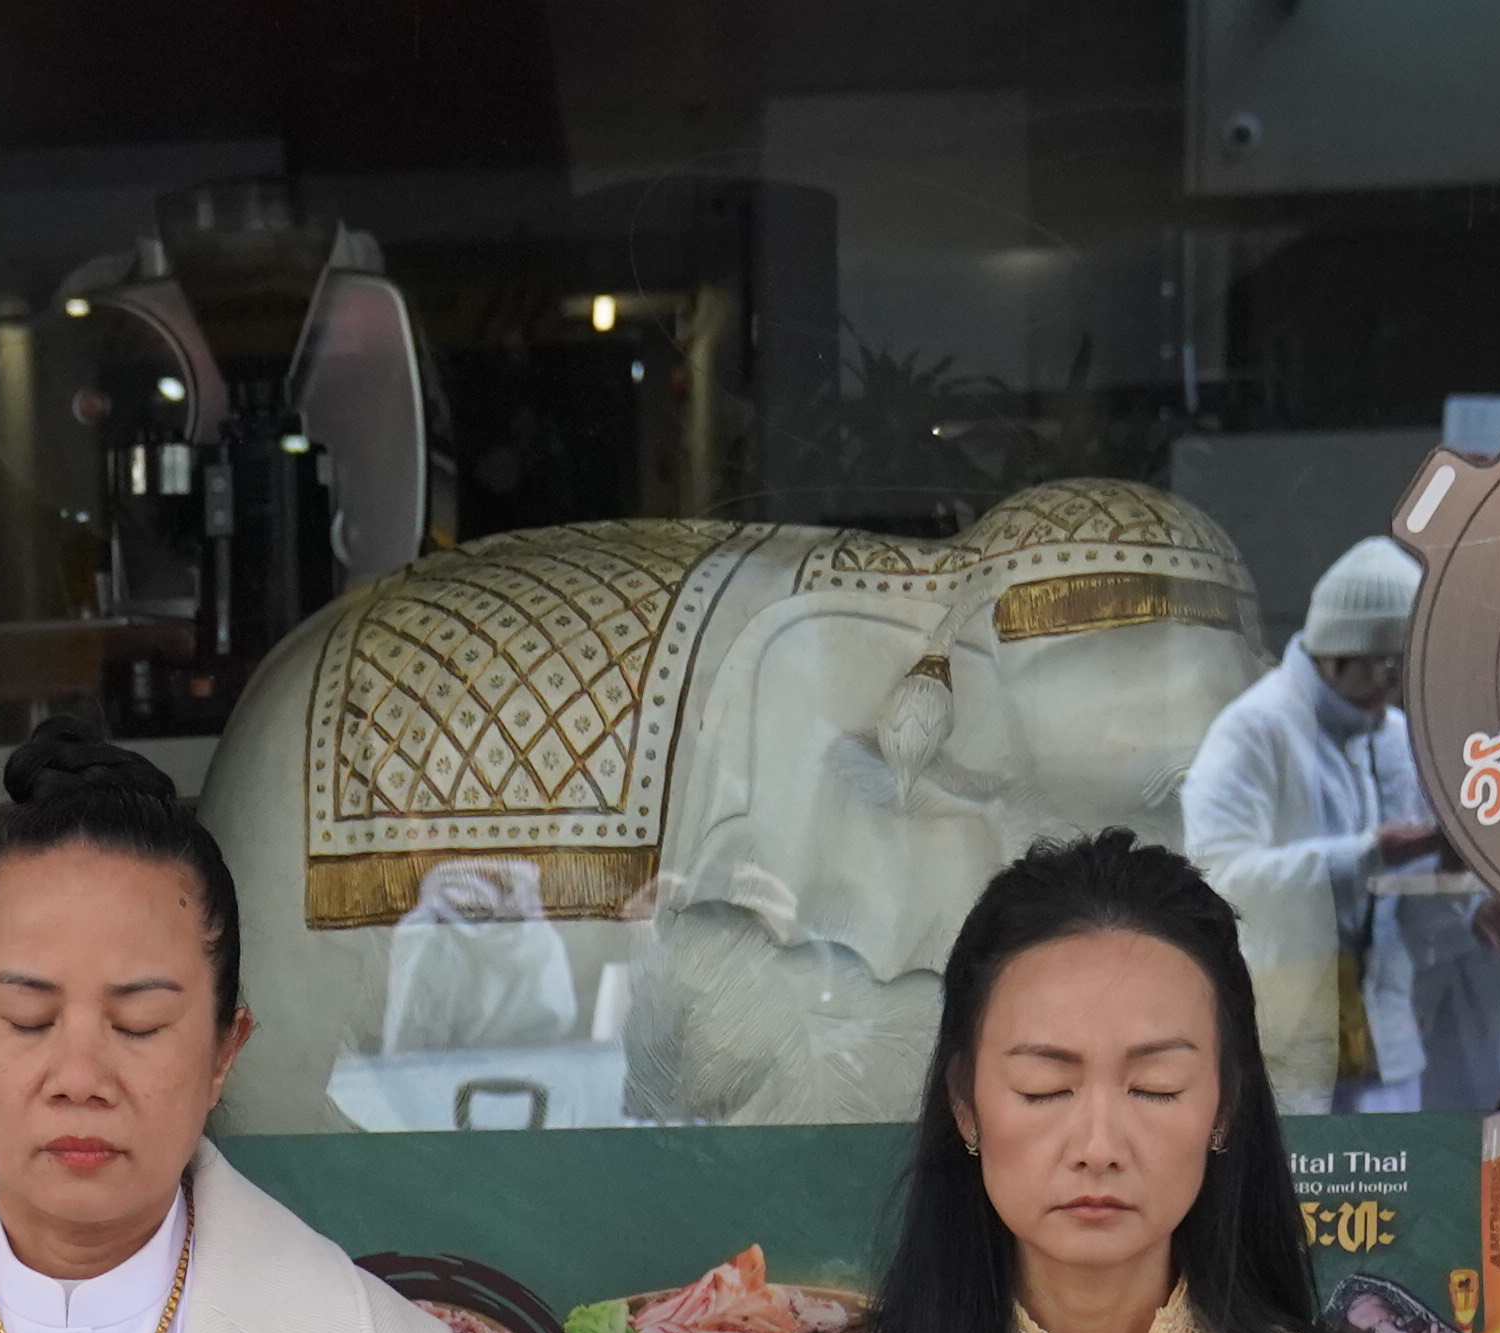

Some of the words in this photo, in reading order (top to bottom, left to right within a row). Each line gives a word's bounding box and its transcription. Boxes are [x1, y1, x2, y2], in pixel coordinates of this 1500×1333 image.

[1290, 1152, 1334, 1174] ital
[1343, 1150, 1408, 1174] Thai
[1327, 1180, 1355, 1194] and
[1359, 1180, 1408, 1195] hotpot
